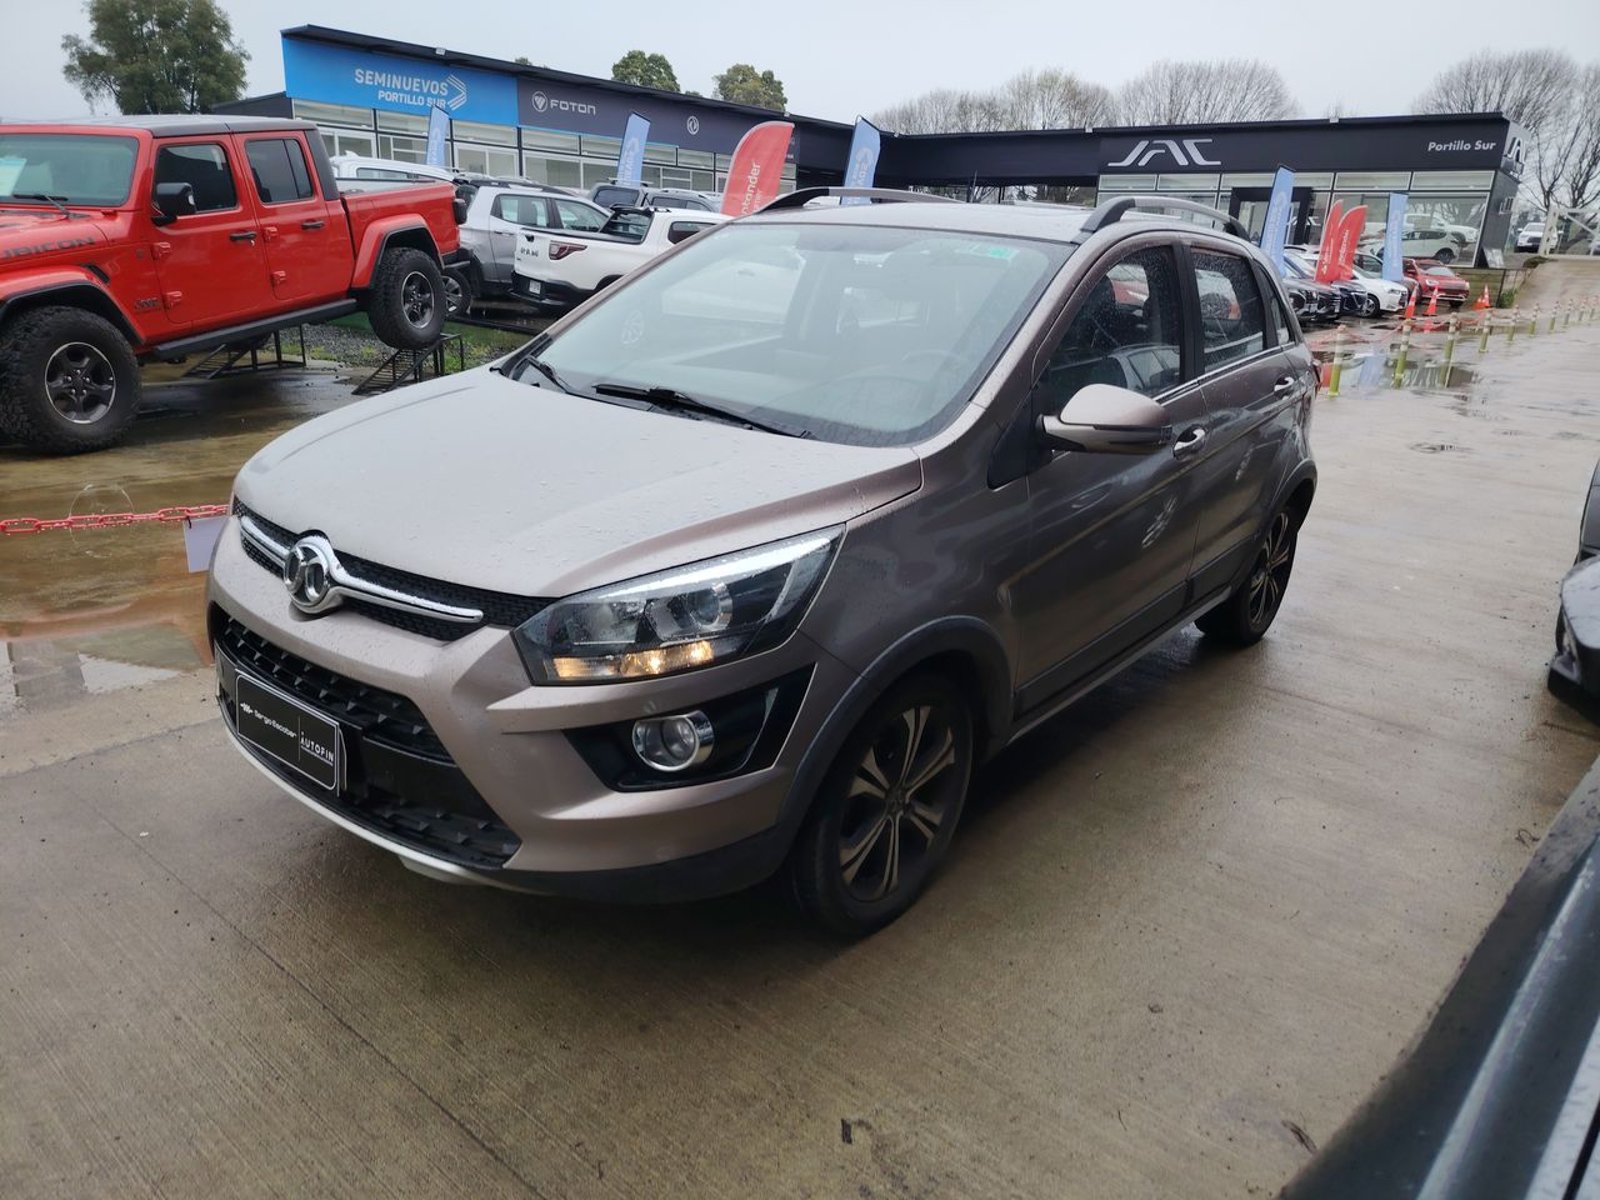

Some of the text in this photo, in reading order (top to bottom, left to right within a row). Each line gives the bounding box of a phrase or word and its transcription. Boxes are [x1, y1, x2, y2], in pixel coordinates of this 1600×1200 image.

[354, 68, 448, 96] SEMINUEVOS
[378, 90, 446, 109] PORTILLO SUR
[550, 99, 596, 116] FOTON
[1107, 138, 1221, 167] JAC
[1428, 140, 1496, 152] Portillo Sur
[520, 247, 538, 257] RAM
